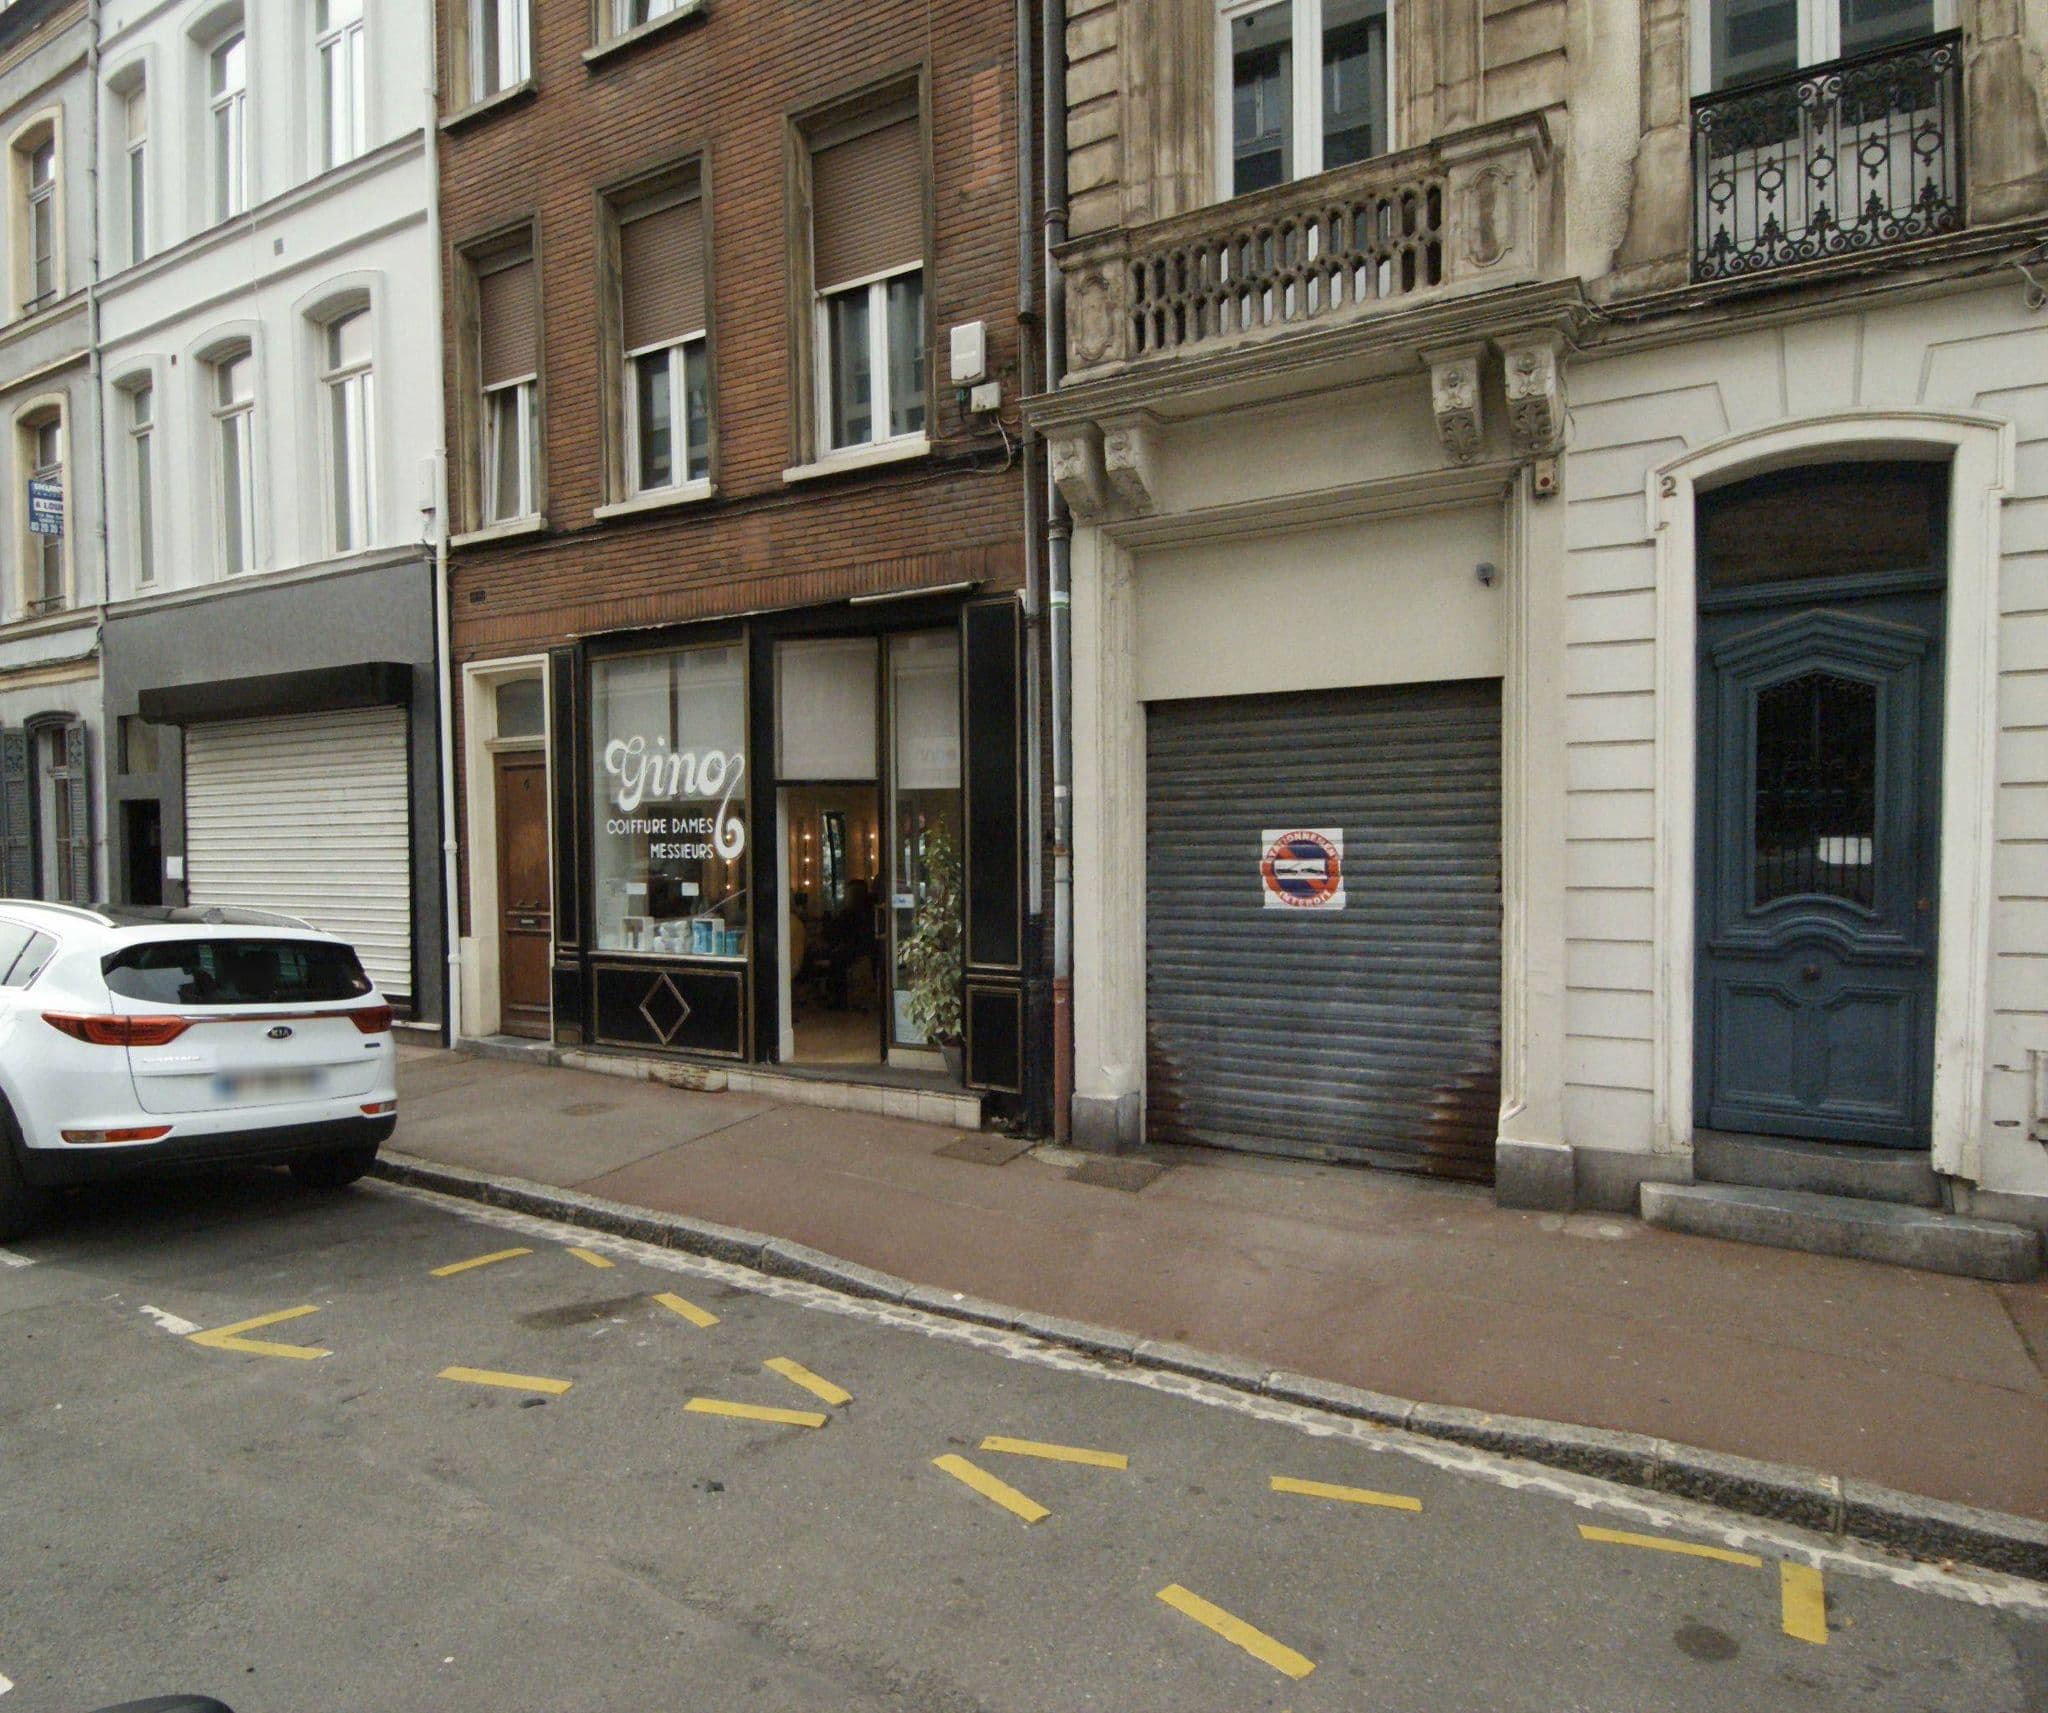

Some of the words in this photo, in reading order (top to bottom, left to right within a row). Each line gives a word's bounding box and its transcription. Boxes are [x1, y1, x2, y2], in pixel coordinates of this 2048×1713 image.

[1661, 476, 1677, 498] 2
[606, 736, 745, 859] Gino
[607, 819, 667, 835] COIFFURE
[672, 817, 714, 834] DAMES
[650, 843, 714, 859] MESSIEURS
[1265, 831, 1338, 862] STATIONNEMEN
